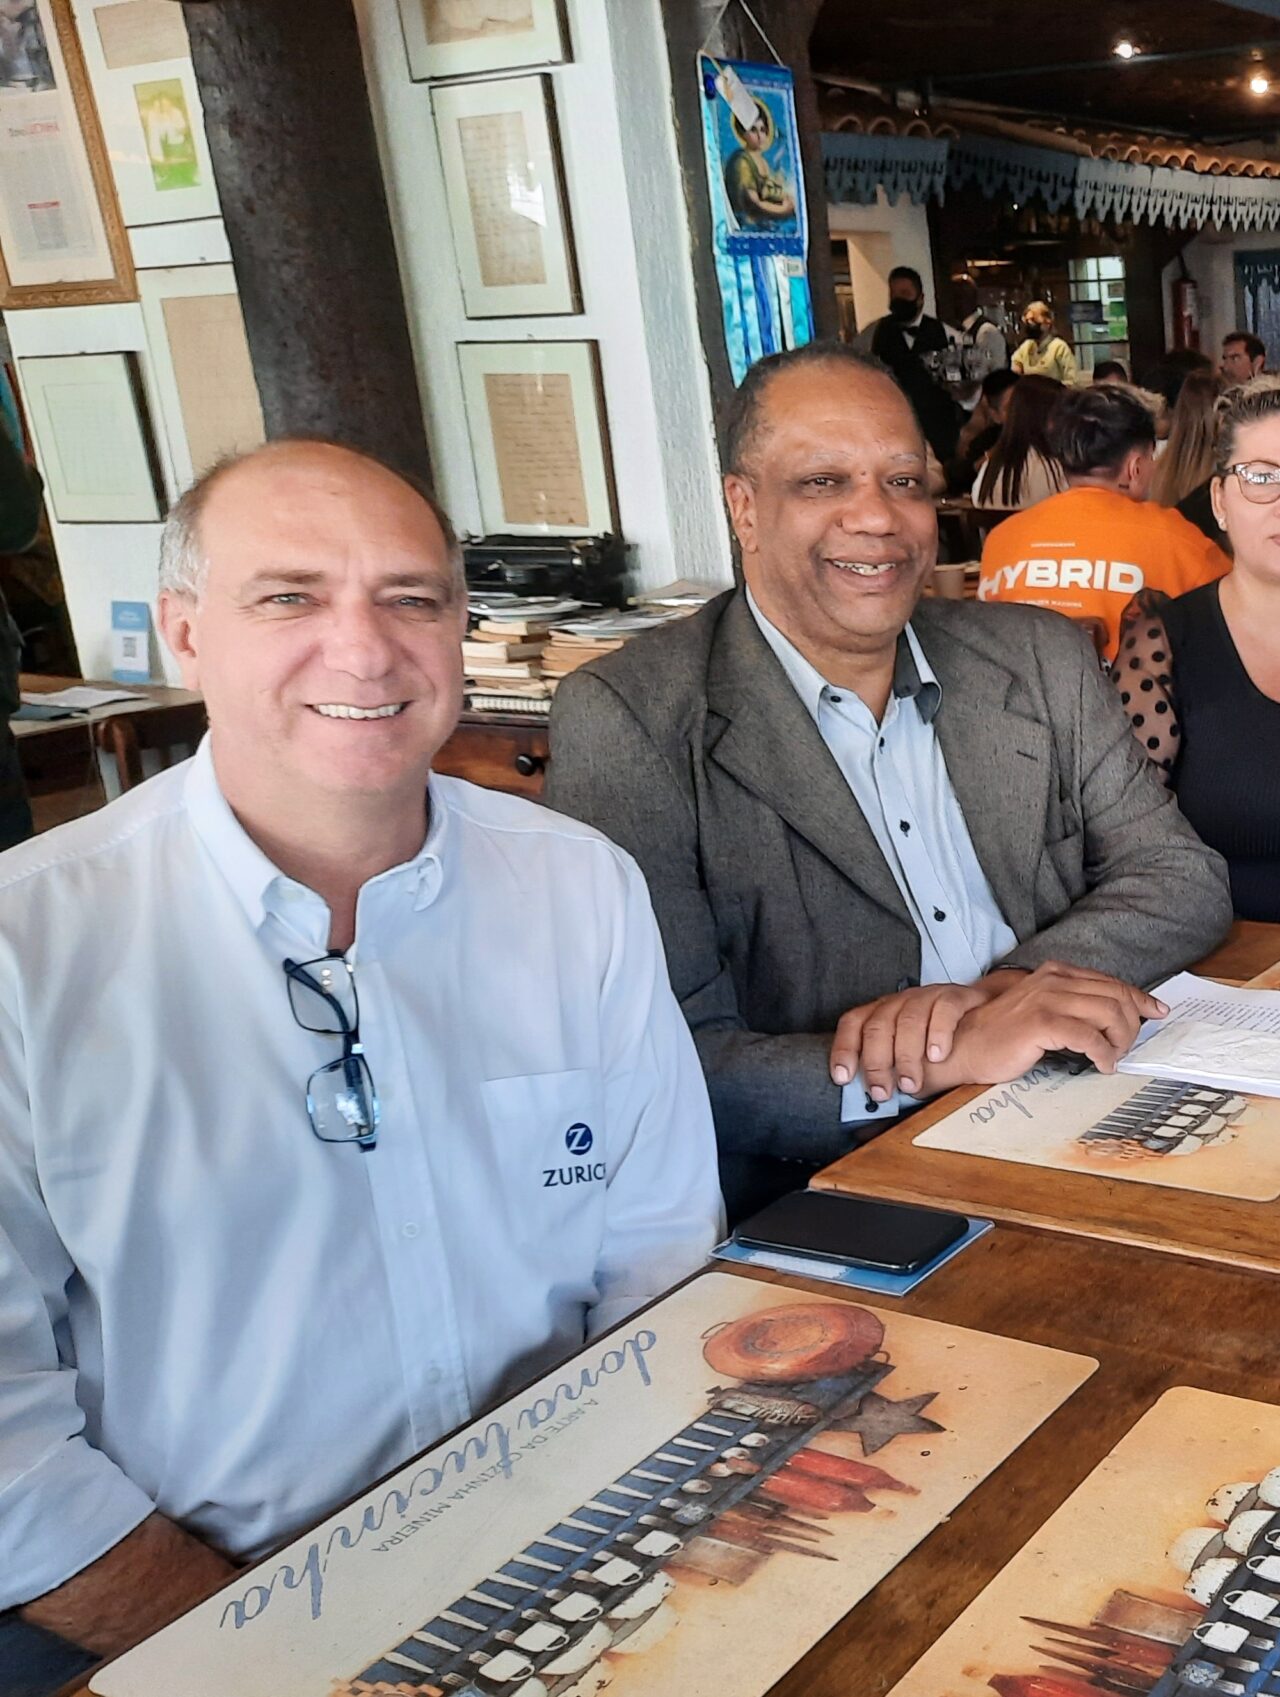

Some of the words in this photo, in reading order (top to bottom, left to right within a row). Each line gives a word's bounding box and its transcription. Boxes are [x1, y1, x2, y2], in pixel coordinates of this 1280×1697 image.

[977, 559, 1144, 601] HYBRID
[969, 1063, 1050, 1124] inha
[542, 1162, 606, 1187] ZURIC
[517, 1330, 657, 1430] dona
[543, 1407, 587, 1434] ARTE
[519, 1434, 548, 1450] DA
[371, 1502, 453, 1552] MINEIRA
